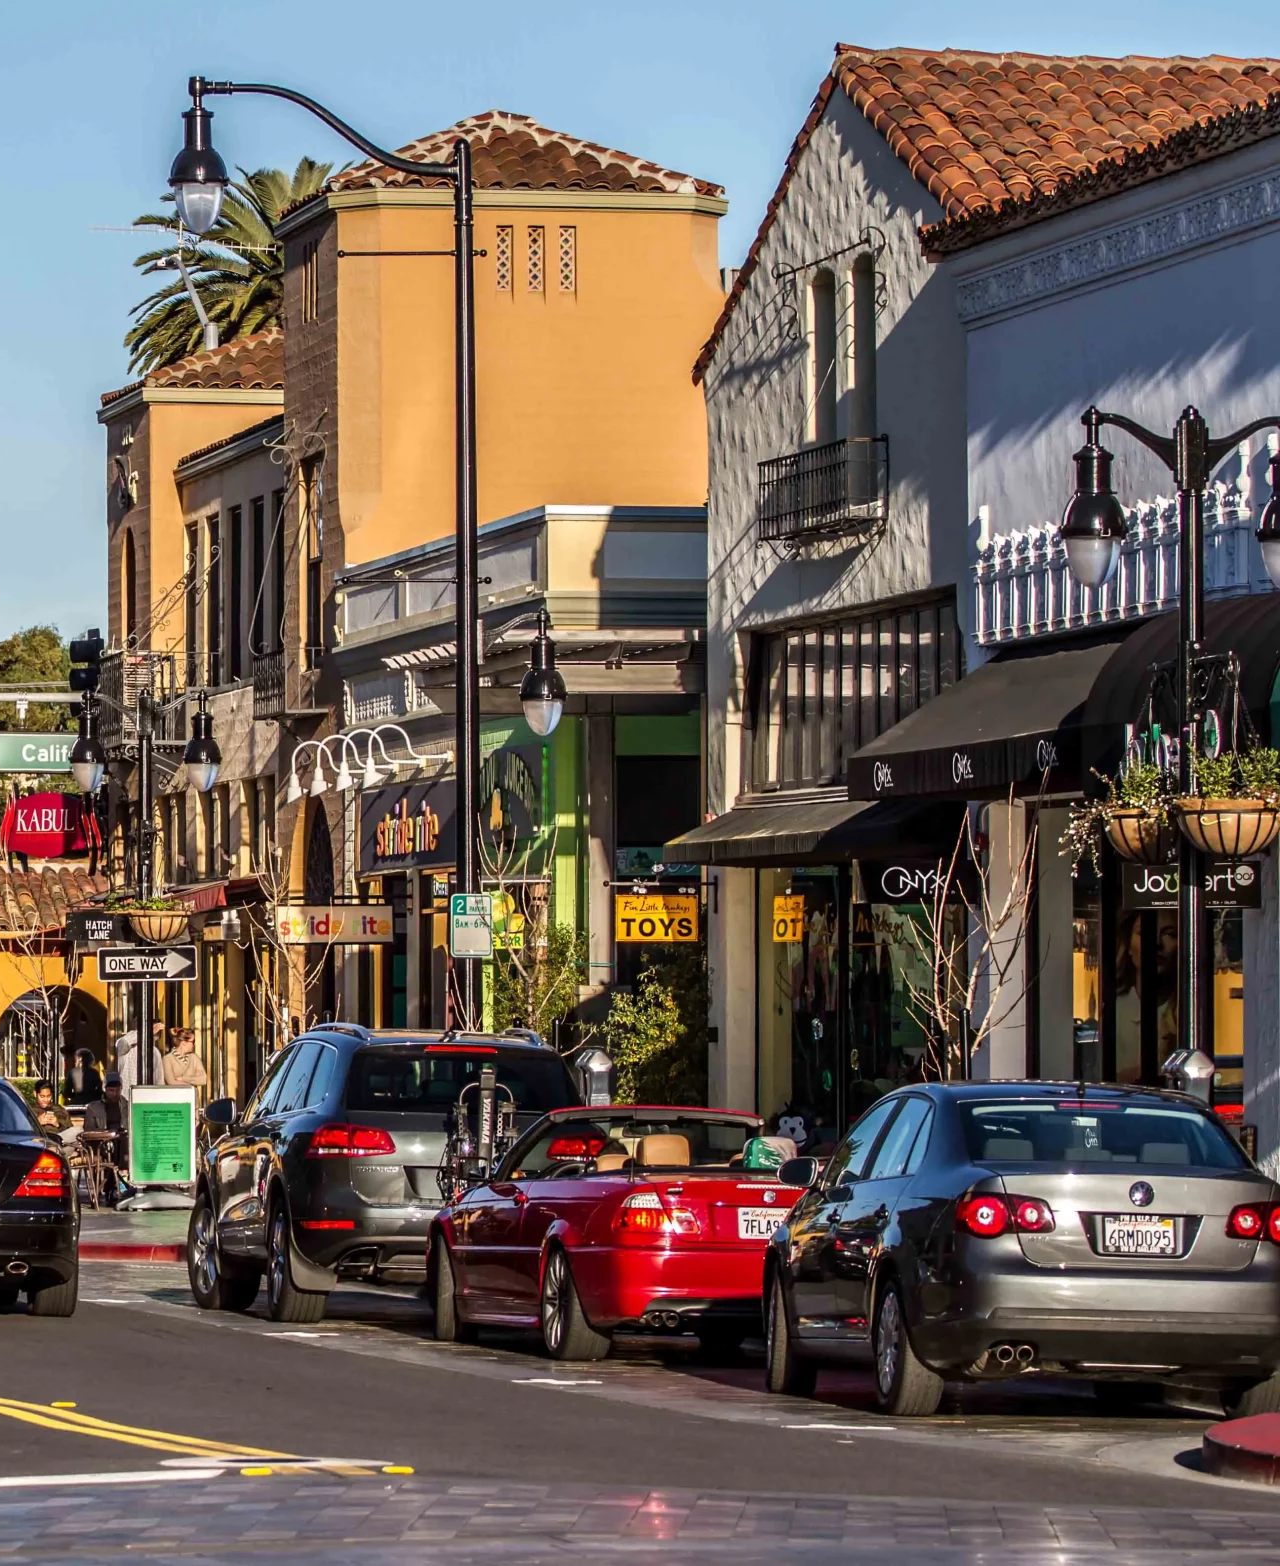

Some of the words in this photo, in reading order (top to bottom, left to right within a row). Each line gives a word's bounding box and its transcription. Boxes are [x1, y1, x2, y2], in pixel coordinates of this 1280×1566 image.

[22, 743, 70, 762] Calif
[873, 761, 892, 792] ONYX
[952, 752, 972, 784] ONYX
[16, 808, 75, 831] KABUL
[376, 797, 414, 857] stride
[415, 799, 439, 852] rite
[881, 866, 947, 898] ONYX
[1133, 868, 1236, 893] Jouert
[456, 899, 465, 913] 2
[639, 900, 659, 912] Little
[85, 920, 113, 930] HATCH
[352, 915, 391, 936] rite
[621, 917, 693, 937] TOYS
[88, 930, 110, 940] LANE
[109, 958, 136, 971] ONE
[140, 957, 167, 970] WAY
[481, 1097, 493, 1144] YAKIMA
[751, 1209, 784, 1219] California
[743, 1219, 784, 1235] 7FLA9
[1108, 1229, 1171, 1247] 6RMD095
